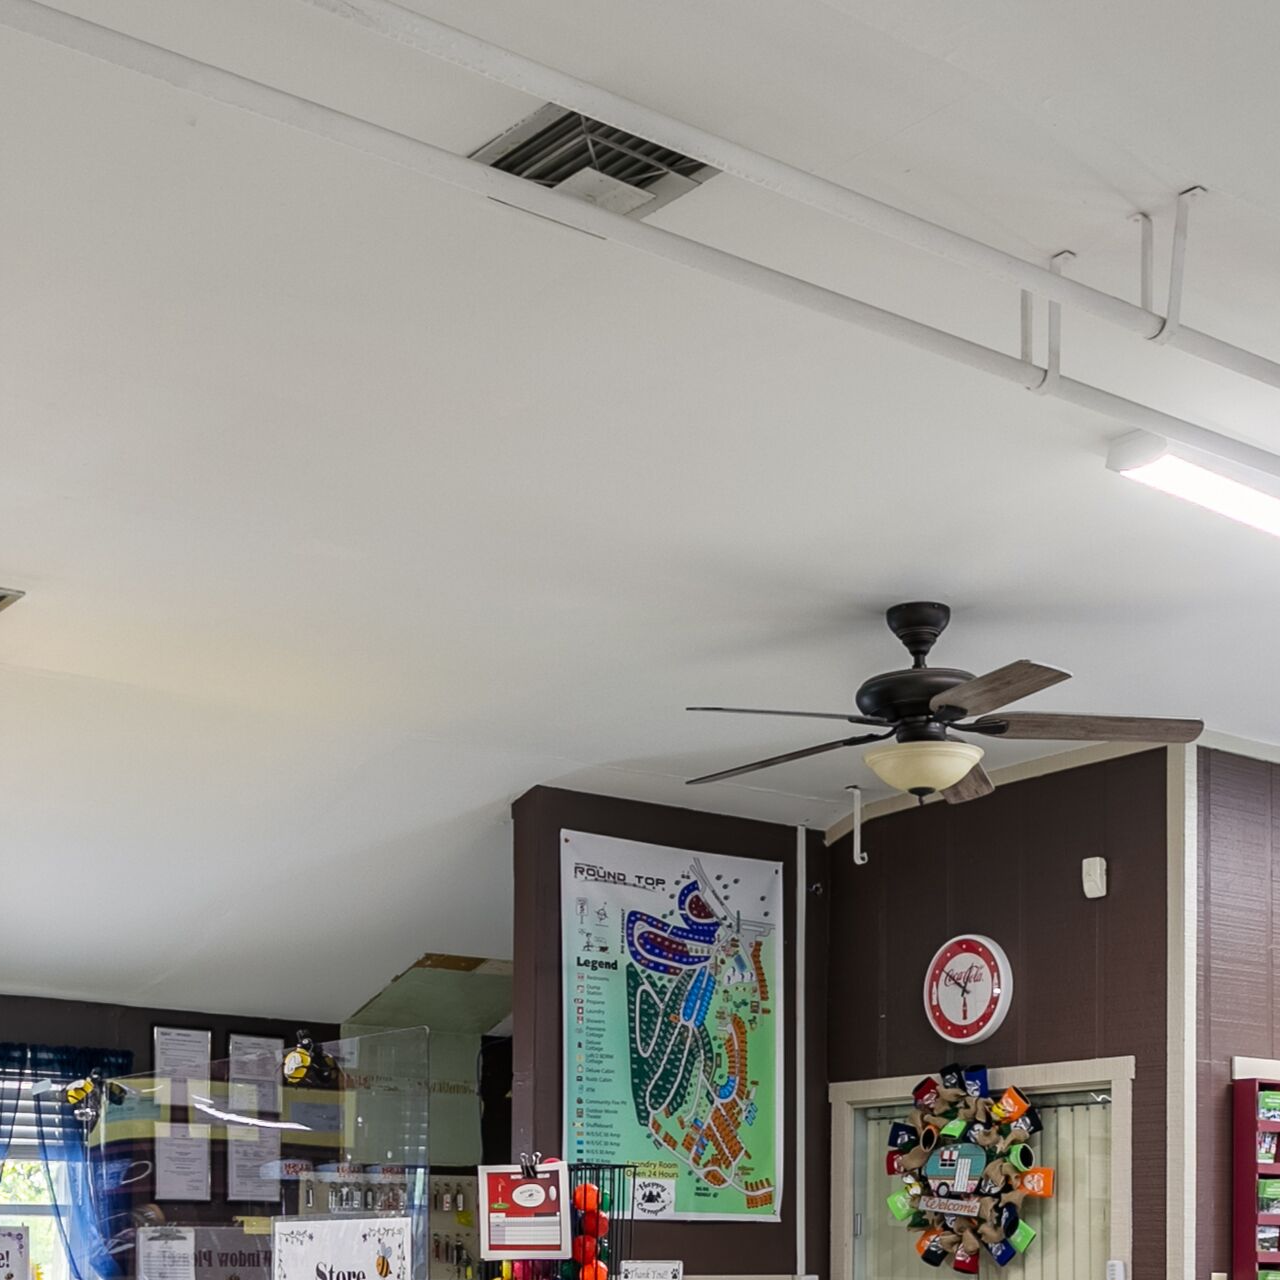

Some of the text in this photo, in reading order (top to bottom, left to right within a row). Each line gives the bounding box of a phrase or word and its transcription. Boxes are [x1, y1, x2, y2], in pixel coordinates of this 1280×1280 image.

[574, 866, 666, 886] ROUND TOP
[577, 957, 618, 971] Legend
[638, 1182, 667, 1192] Happy
[925, 1198, 978, 1215] Welcome
